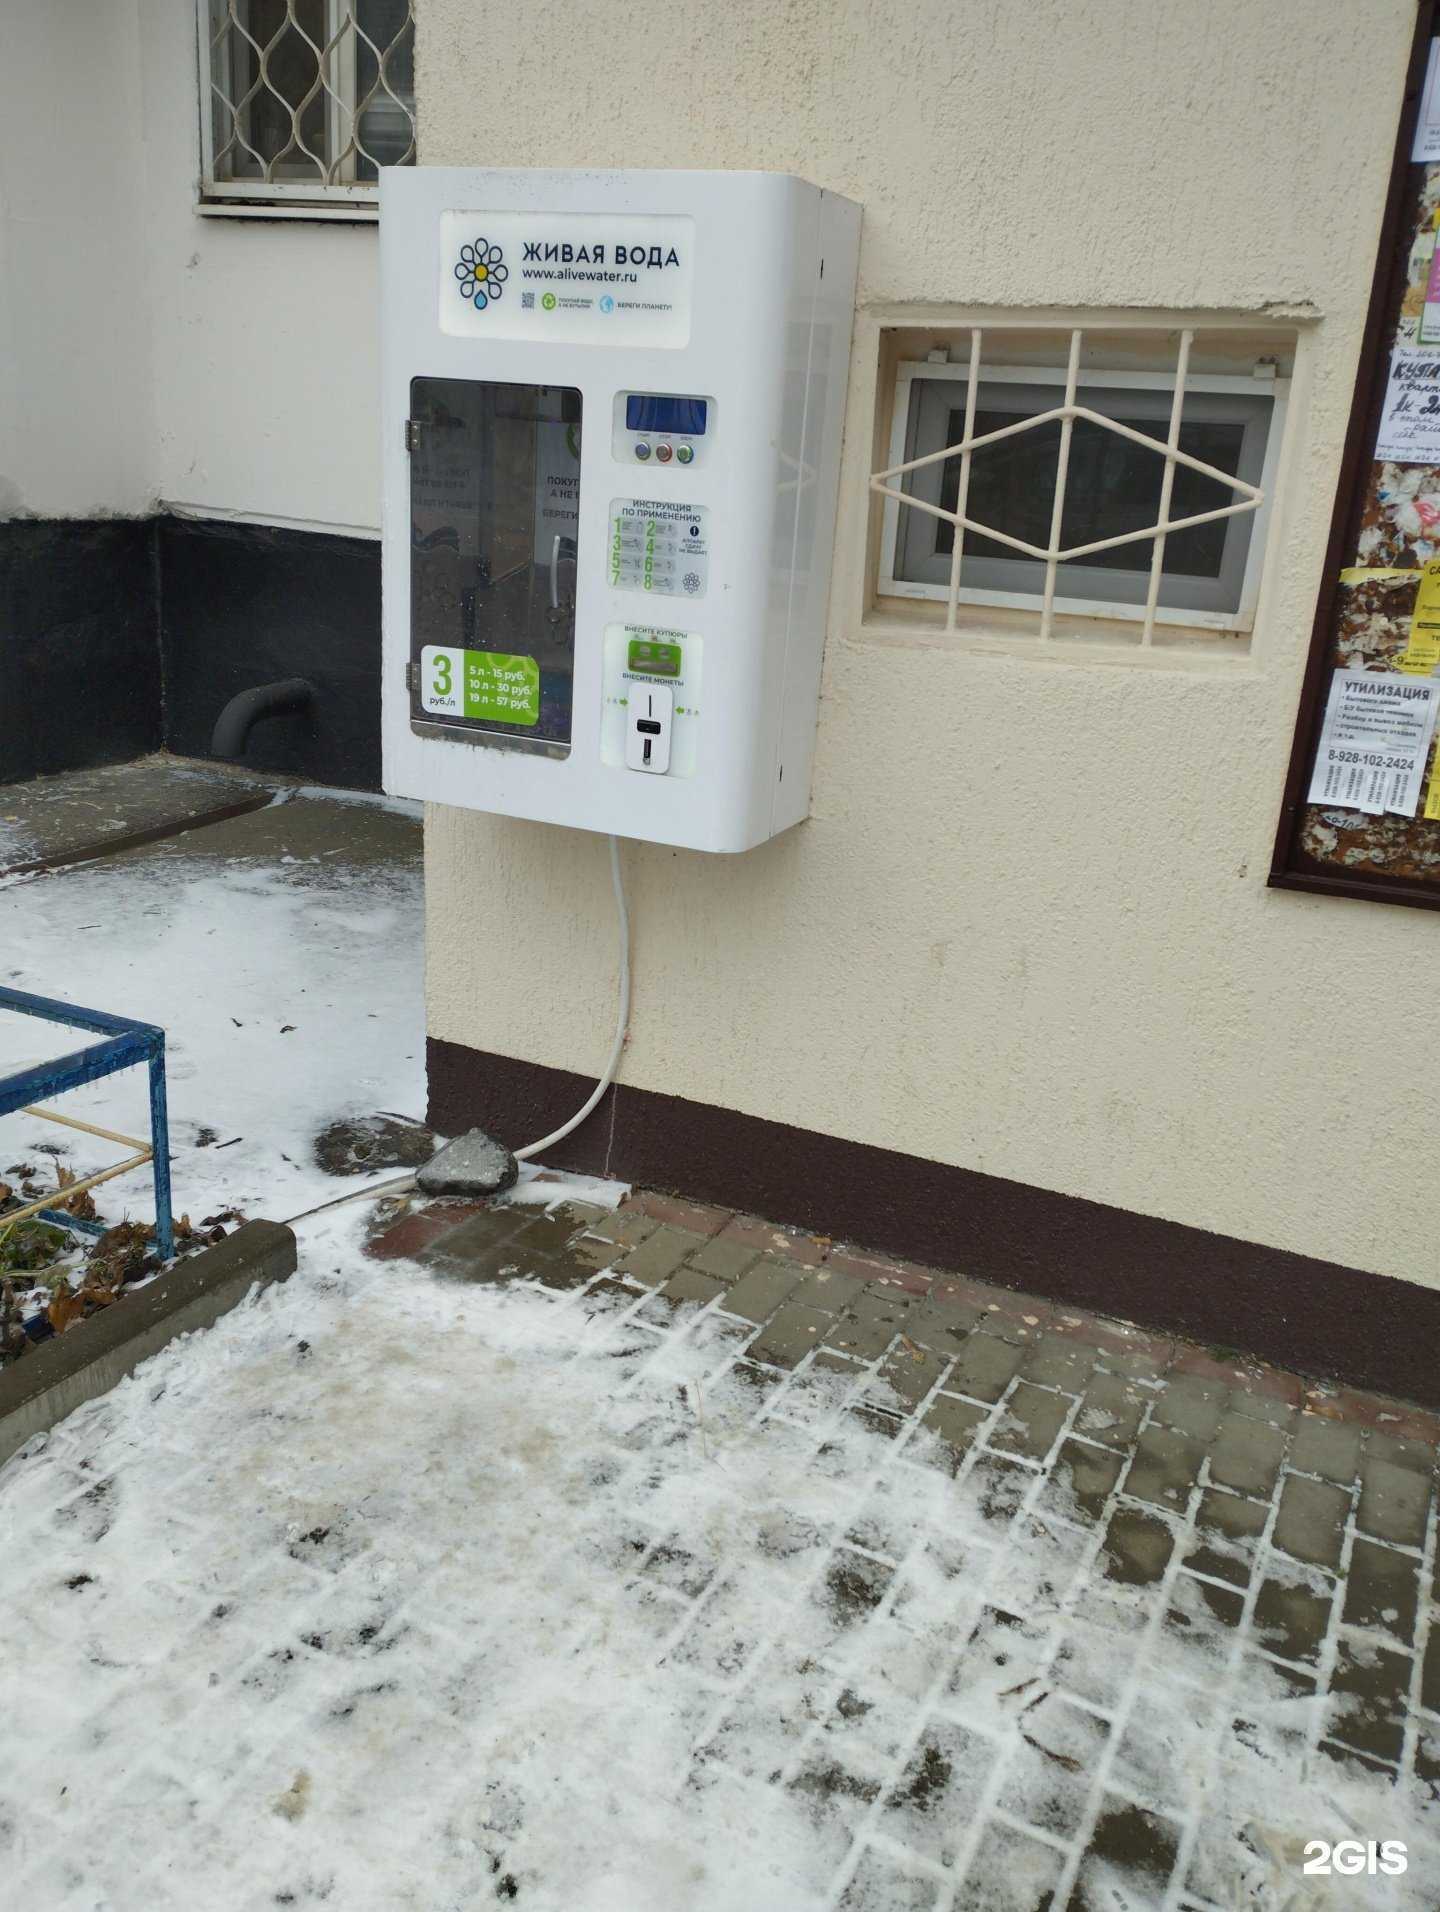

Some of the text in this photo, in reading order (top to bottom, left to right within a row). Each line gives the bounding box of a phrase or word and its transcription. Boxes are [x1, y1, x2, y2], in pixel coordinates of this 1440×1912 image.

[523, 242, 680, 269] ЖИВАЯ ВОДА
[522, 268, 638, 283] www.alivewater.ru
[632, 500, 692, 512] ИНСТРУКЦИЯ
[622, 508, 701, 522] ПО ПРИМЕНЕНИЮ
[646, 520, 655, 537] 2
[613, 535, 621, 551] 3
[646, 538, 654, 555] 4
[612, 552, 620, 569] 5
[645, 556, 652, 573] 6
[612, 570, 620, 586] 7
[644, 574, 652, 590] 8
[625, 625, 655, 635] ВНЕСИТЕ
[656, 629, 688, 639] КУПЮРЫ
[432, 654, 452, 696] 3
[469, 665, 477, 675] 5
[493, 668, 503, 678] 15
[504, 670, 526, 681] руб.
[622, 673, 685, 687] ВНЕСИТЕ МОНЕТЫ
[470, 680, 480, 689] 10
[481, 682, 488, 690] л
[497, 682, 509, 692] 30
[511, 685, 533, 697] руб.
[1345, 681, 1431, 700] УТИЛИЗАЦИЯ
[429, 697, 456, 707] руб./л
[470, 693, 480, 703] 19
[481, 696, 488, 704] л
[496, 696, 508, 706] 57
[510, 699, 531, 710] руб.
[1328, 749, 1415, 770] 8-928-102-2424
